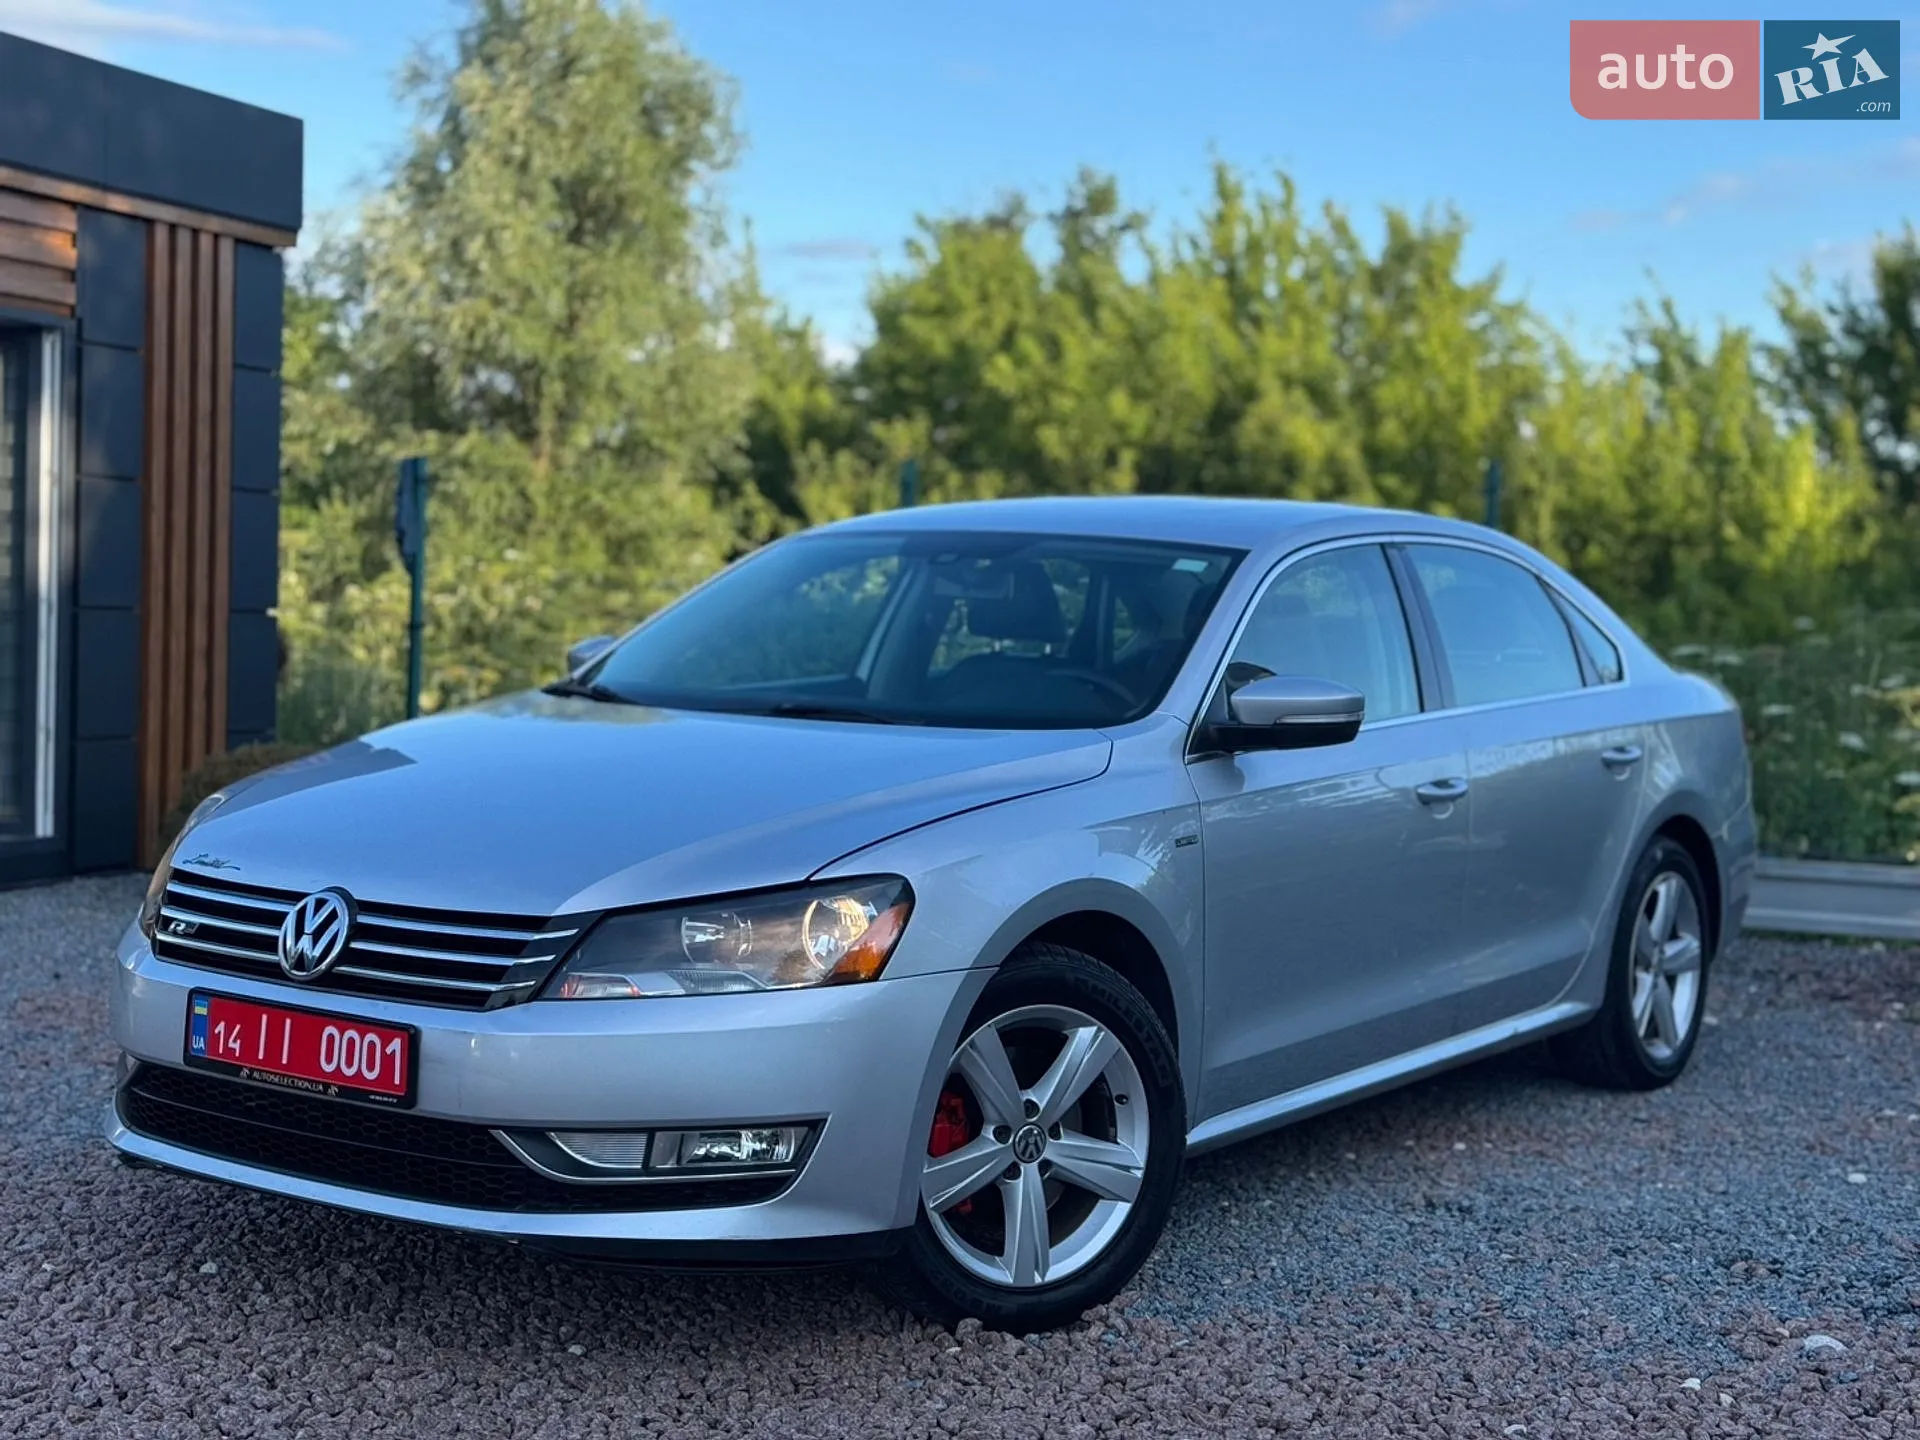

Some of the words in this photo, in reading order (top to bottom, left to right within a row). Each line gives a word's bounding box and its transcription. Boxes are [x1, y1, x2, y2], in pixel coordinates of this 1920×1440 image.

[192, 1037, 205, 1050] UA
[214, 1020, 241, 1057] 14
[320, 1025, 402, 1086] 0001
